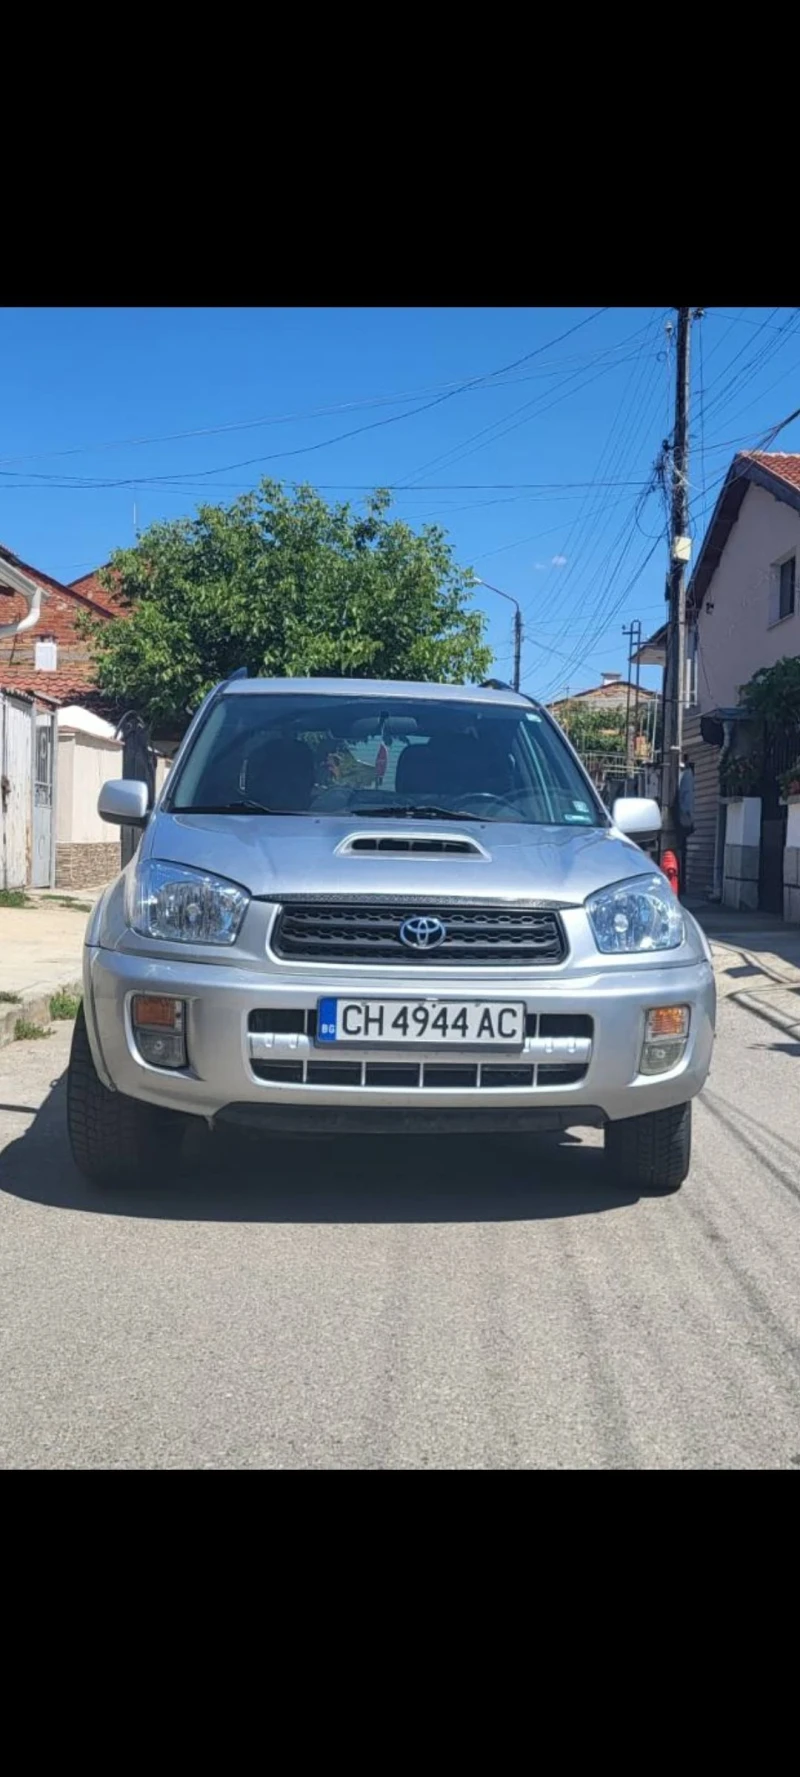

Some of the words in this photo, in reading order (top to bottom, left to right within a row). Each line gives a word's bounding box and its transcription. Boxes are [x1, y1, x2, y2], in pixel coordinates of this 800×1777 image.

[322, 1023, 335, 1034] BG
[342, 1004, 384, 1036] CH
[391, 1006, 469, 1038] 4944
[477, 1007, 517, 1039] AC
